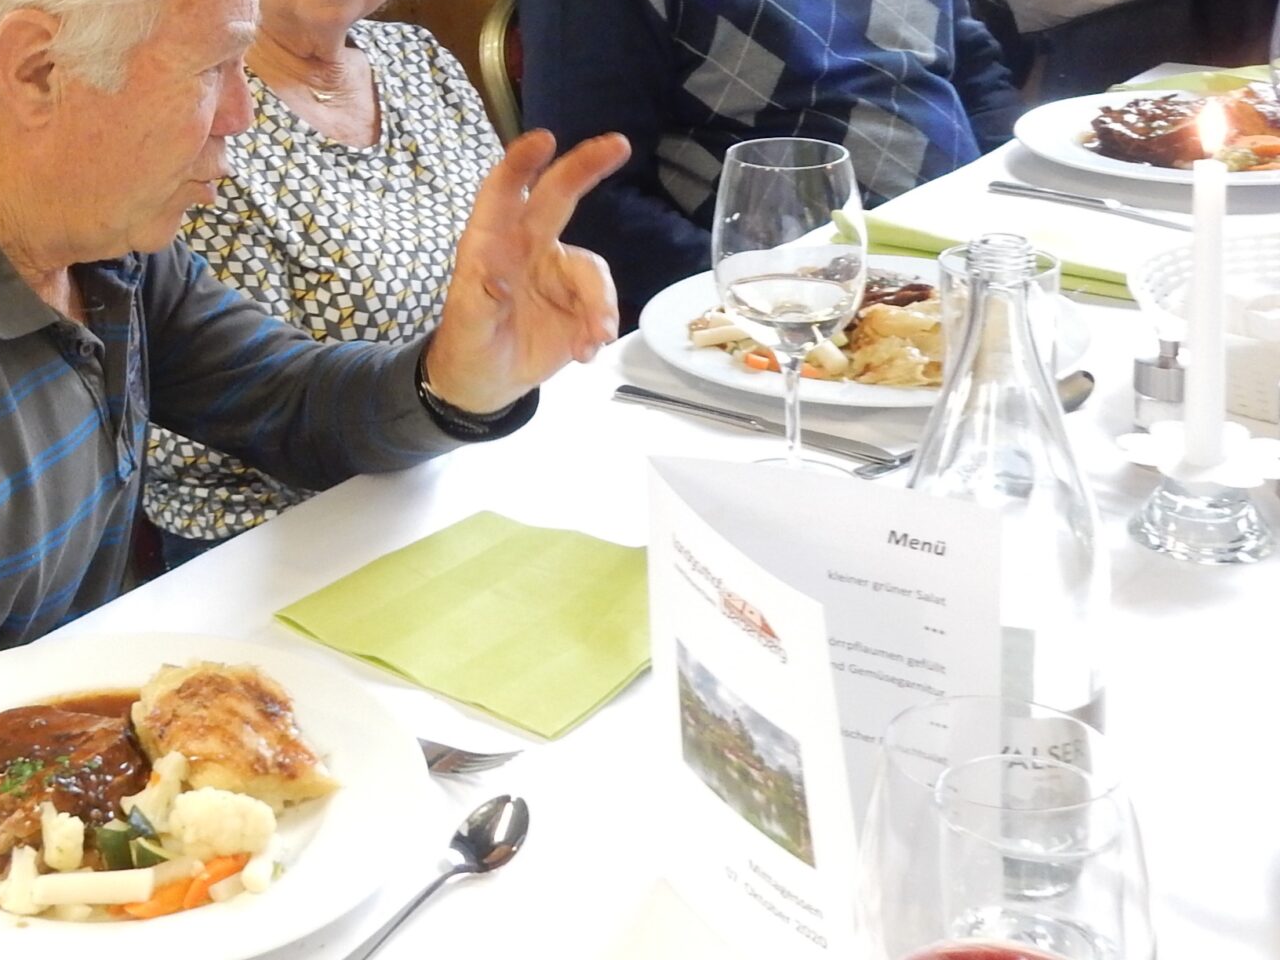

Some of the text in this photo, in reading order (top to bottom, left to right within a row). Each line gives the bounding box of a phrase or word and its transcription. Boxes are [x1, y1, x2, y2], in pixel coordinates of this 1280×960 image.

[887, 530, 947, 556] Menü
[827, 569, 947, 607] kleiner grüner Salat
